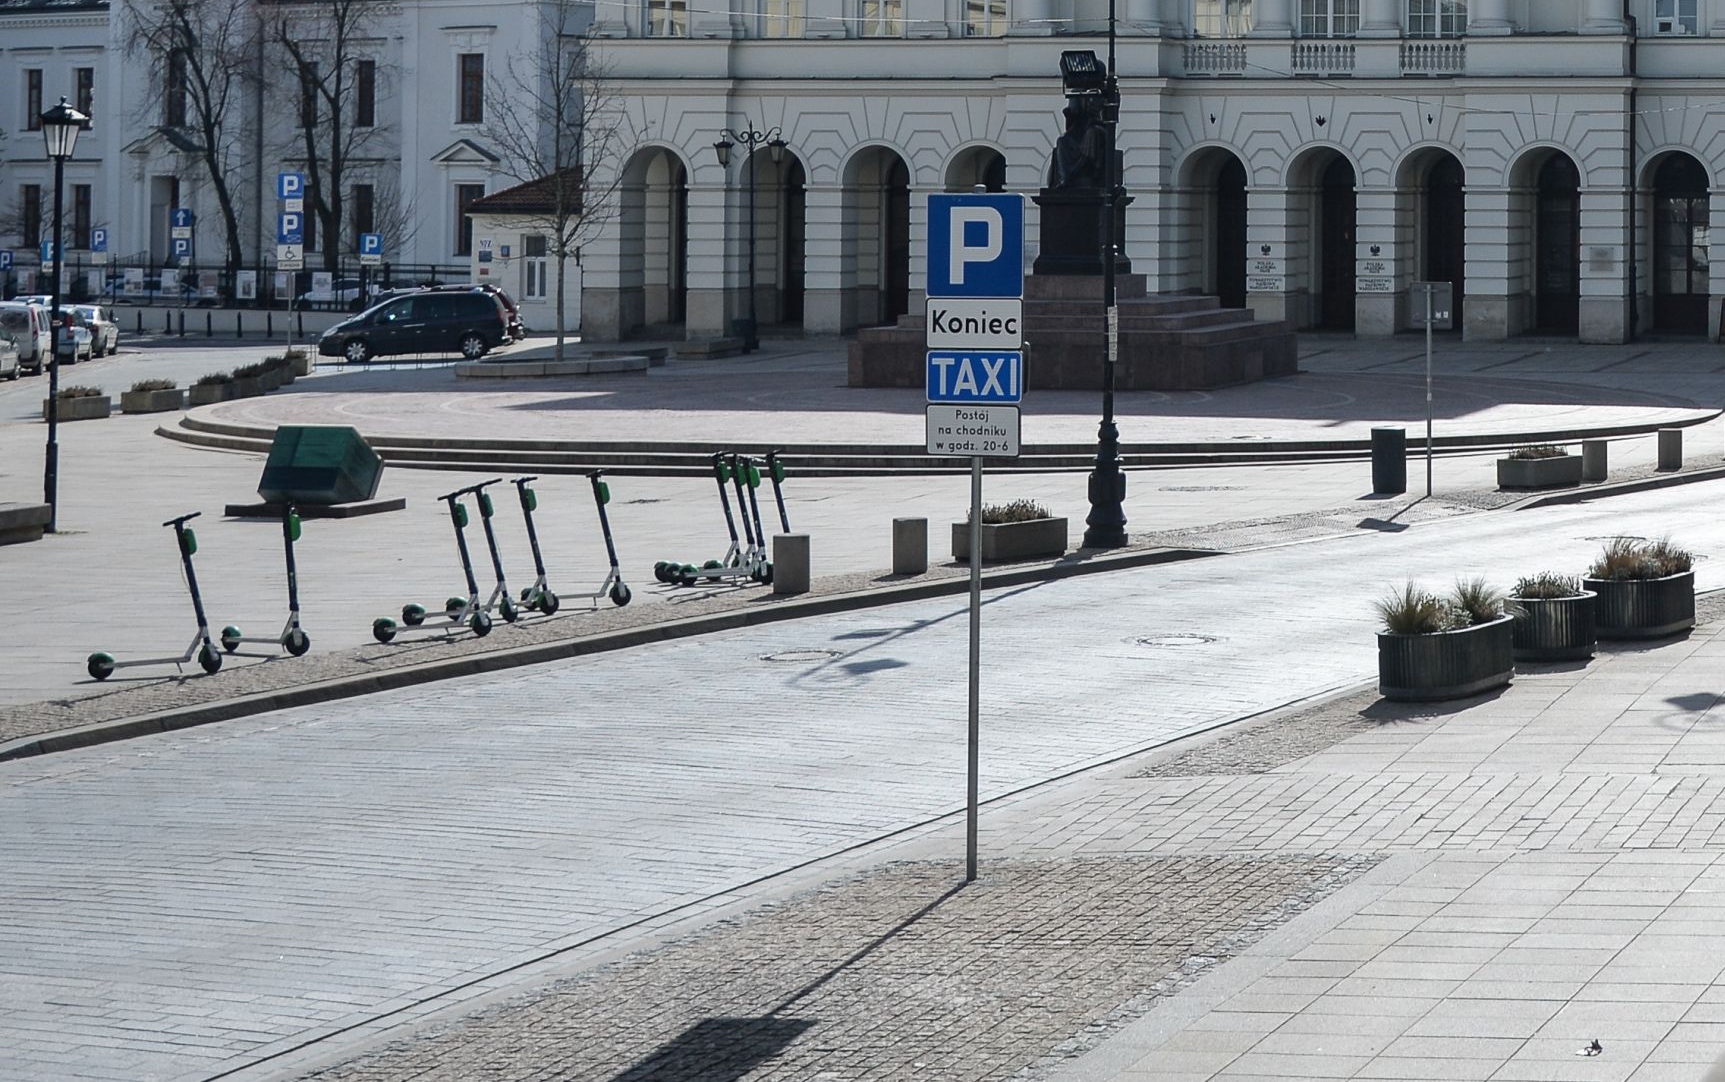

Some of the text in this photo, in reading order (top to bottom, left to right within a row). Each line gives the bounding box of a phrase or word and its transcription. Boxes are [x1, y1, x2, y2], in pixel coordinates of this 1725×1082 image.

[283, 175, 299, 196] P
[283, 214, 298, 235] P
[94, 230, 105, 247] P
[365, 235, 378, 252] P
[949, 206, 1003, 285] P
[176, 240, 187, 255] P
[1, 252, 11, 268] P
[931, 309, 1018, 335] Koniec
[931, 357, 1018, 396] TAXI
[955, 409, 989, 422] Postój
[938, 425, 1007, 436] na chodniku
[948, 440, 978, 453] godz.
[983, 441, 1009, 451] 20-6
